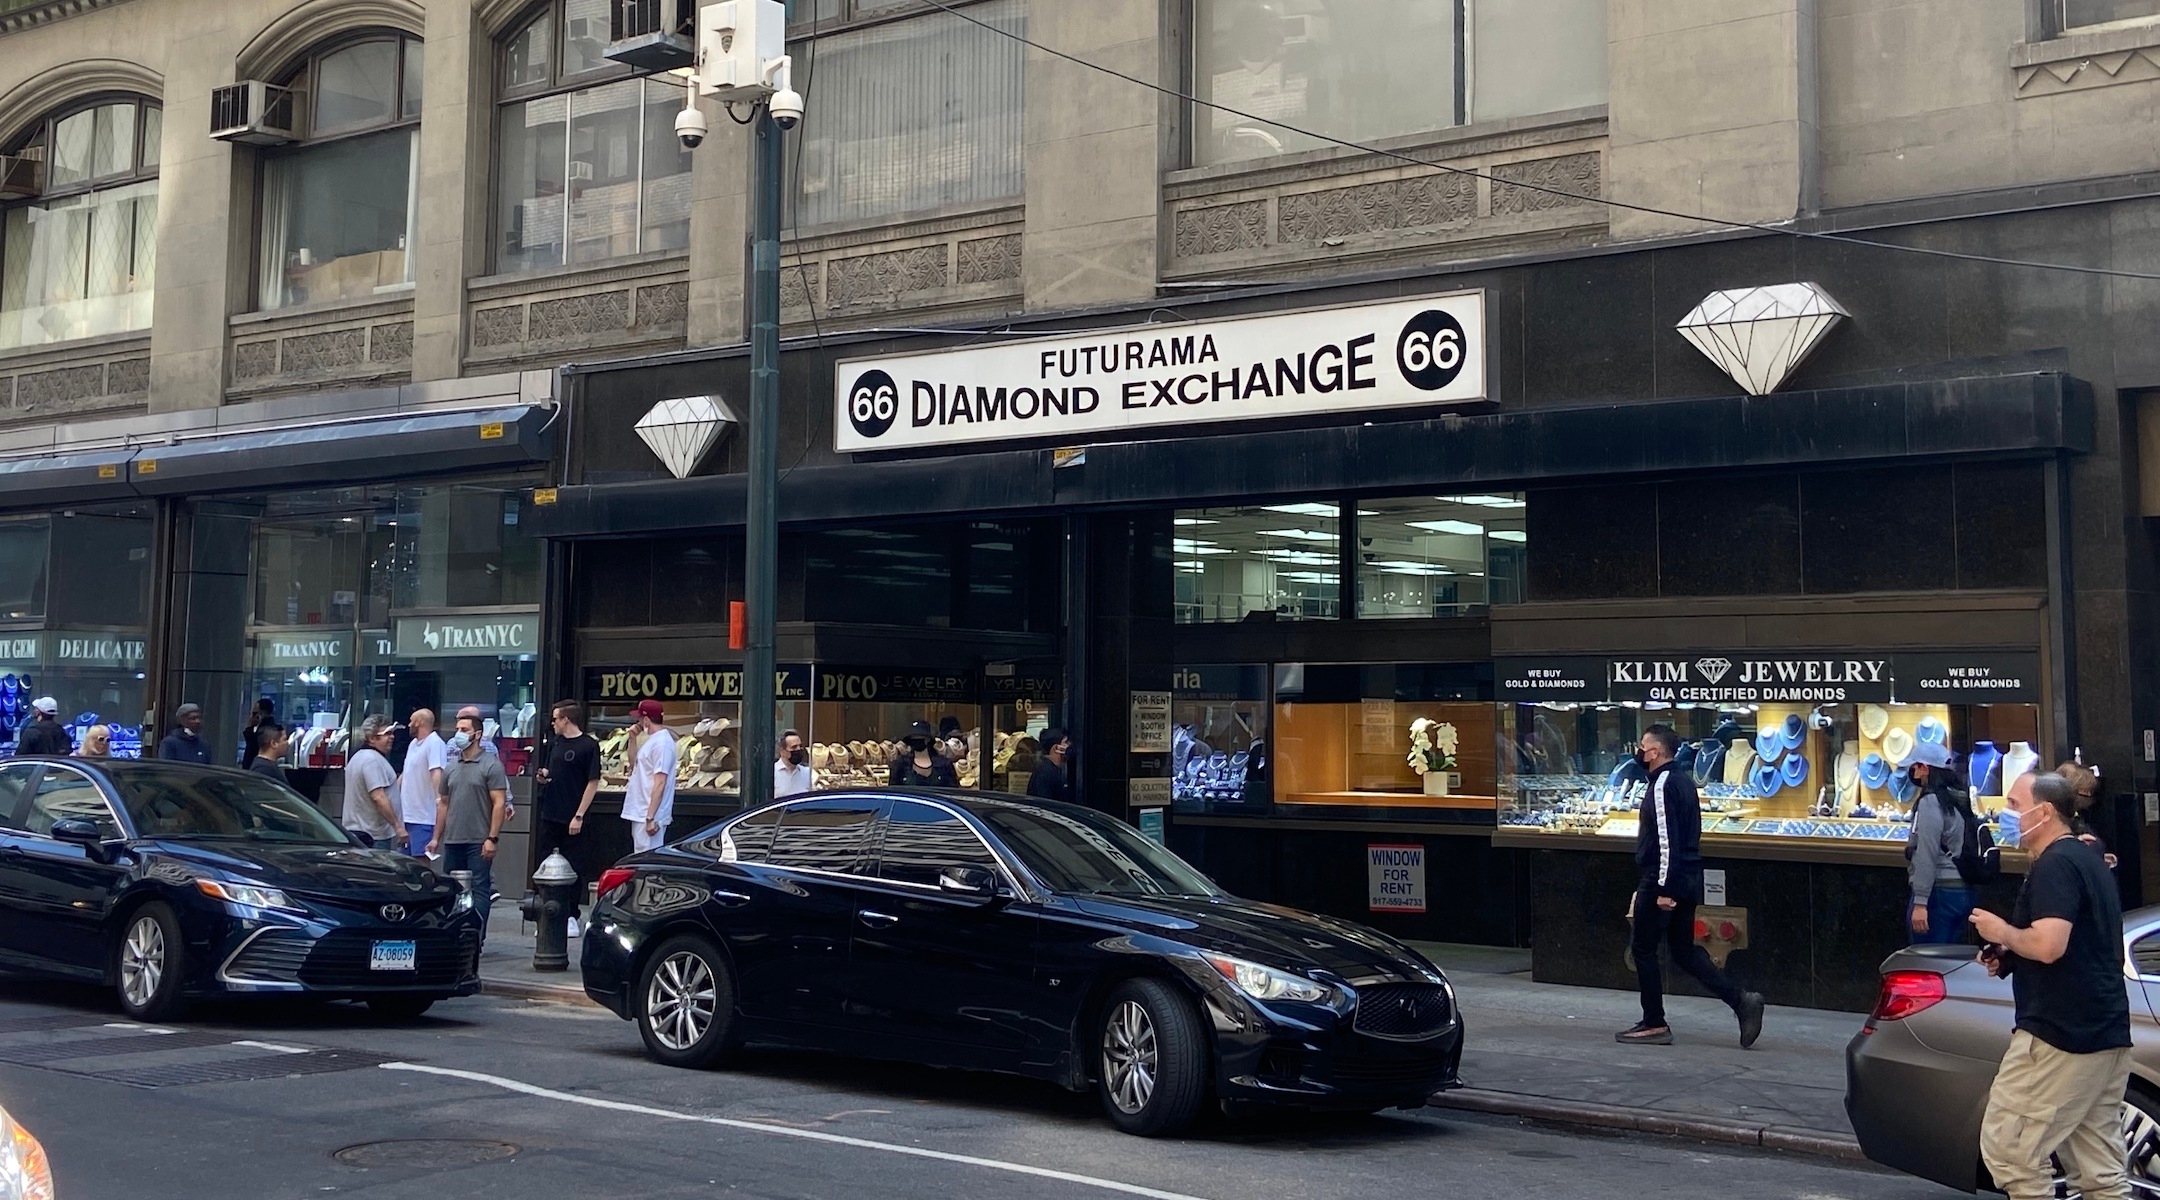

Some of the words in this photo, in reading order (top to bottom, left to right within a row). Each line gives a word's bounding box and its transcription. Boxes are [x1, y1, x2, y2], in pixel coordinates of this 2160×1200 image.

[1041, 334, 1219, 379] FUTURAMA
[1402, 328, 1460, 372] 66
[911, 378, 1100, 428] DIAMOND
[1121, 333, 1376, 409] EXCHANGE
[852, 385, 893, 422] 66
[12, 639, 36, 658] GEM
[58, 639, 145, 660] DELICATE
[1528, 670, 1541, 678] WE
[1543, 670, 1561, 678] BUY
[1613, 661, 1689, 683] KLIM
[1739, 660, 1885, 683] JEWELRY
[1948, 668, 1965, 676] WE
[1968, 668, 1990, 676] BUY
[600, 672, 658, 697] PICO
[1173, 668, 1201, 689] ria
[1505, 680, 1529, 688] GOLD
[1531, 680, 1537, 688] &
[1538, 680, 1585, 688] DIAMONDS
[1920, 679, 1949, 688] GOLD
[1953, 680, 1960, 688] &
[1962, 679, 2021, 688] DIAMONDS
[822, 673, 878, 699] PICO
[881, 676, 968, 689] JEWELRY
[1132, 695, 1148, 704] FOR
[1150, 696, 1170, 705] RENT
[1650, 687, 1675, 700] GIA
[1680, 687, 1757, 700] CERTIFIED
[1763, 687, 1846, 700] DIAMONDS
[1016, 699, 1032, 711] 66
[1141, 712, 1167, 720] WINDOW
[1140, 722, 1166, 730] BOOTHS
[1140, 732, 1162, 740] OFFICE
[1371, 850, 1421, 866] WINDOW
[1384, 869, 1409, 881] FOR
[1380, 883, 1413, 894] RENT
